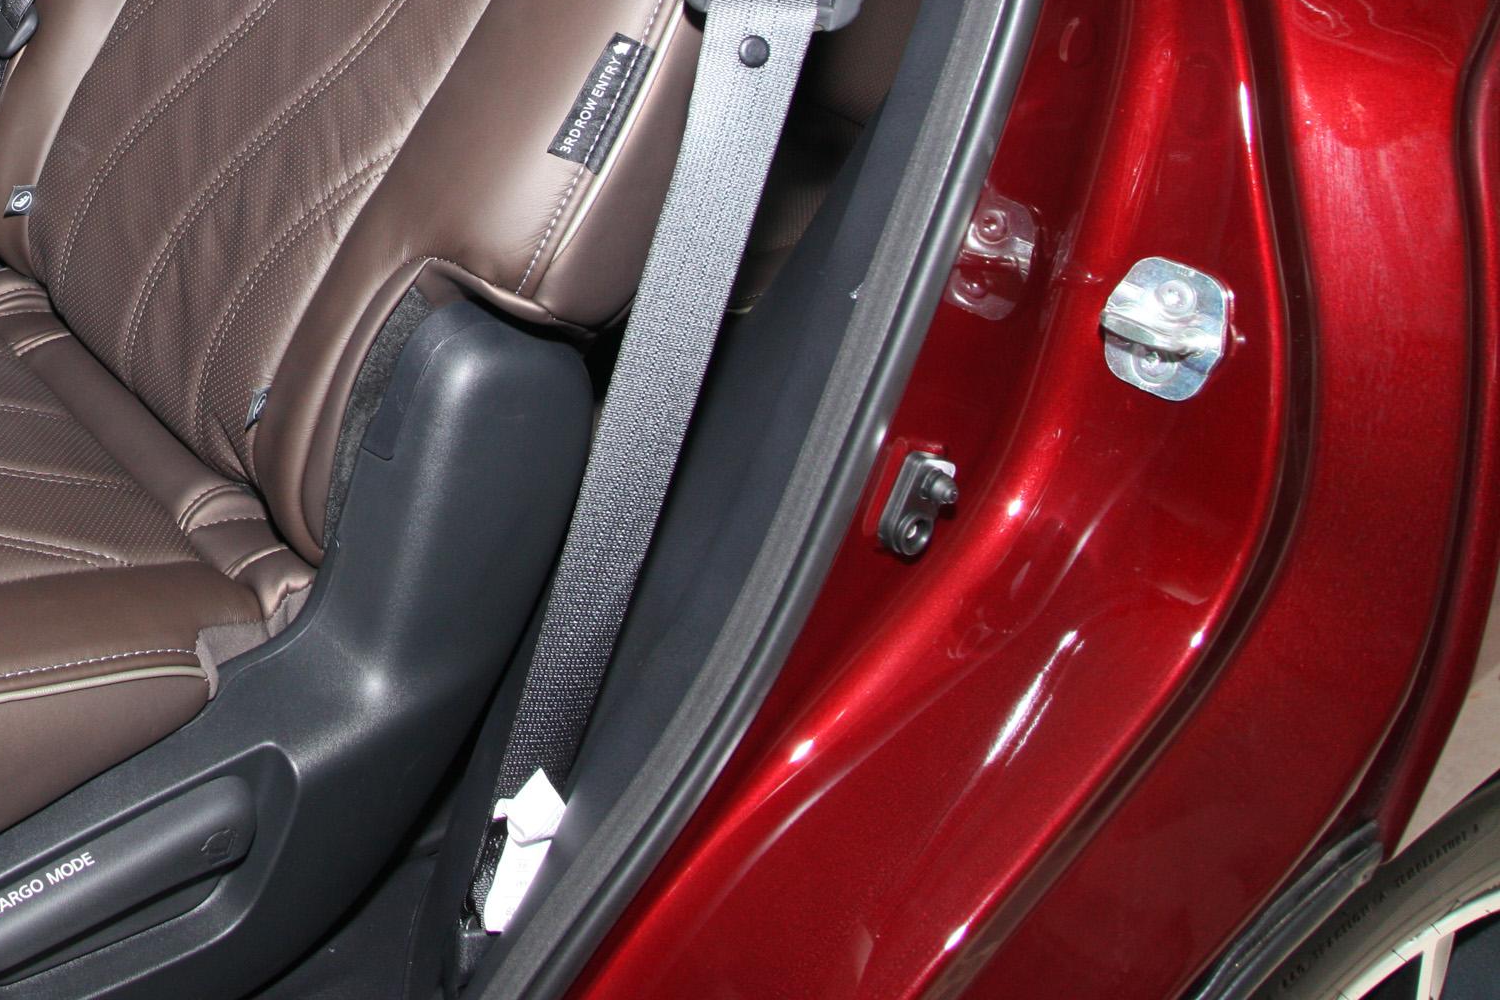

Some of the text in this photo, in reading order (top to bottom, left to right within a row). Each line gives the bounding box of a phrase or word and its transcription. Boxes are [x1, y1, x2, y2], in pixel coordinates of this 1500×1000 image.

[560, 55, 622, 154] 3RD ROW ENTRY
[45, 851, 96, 886] MODE
